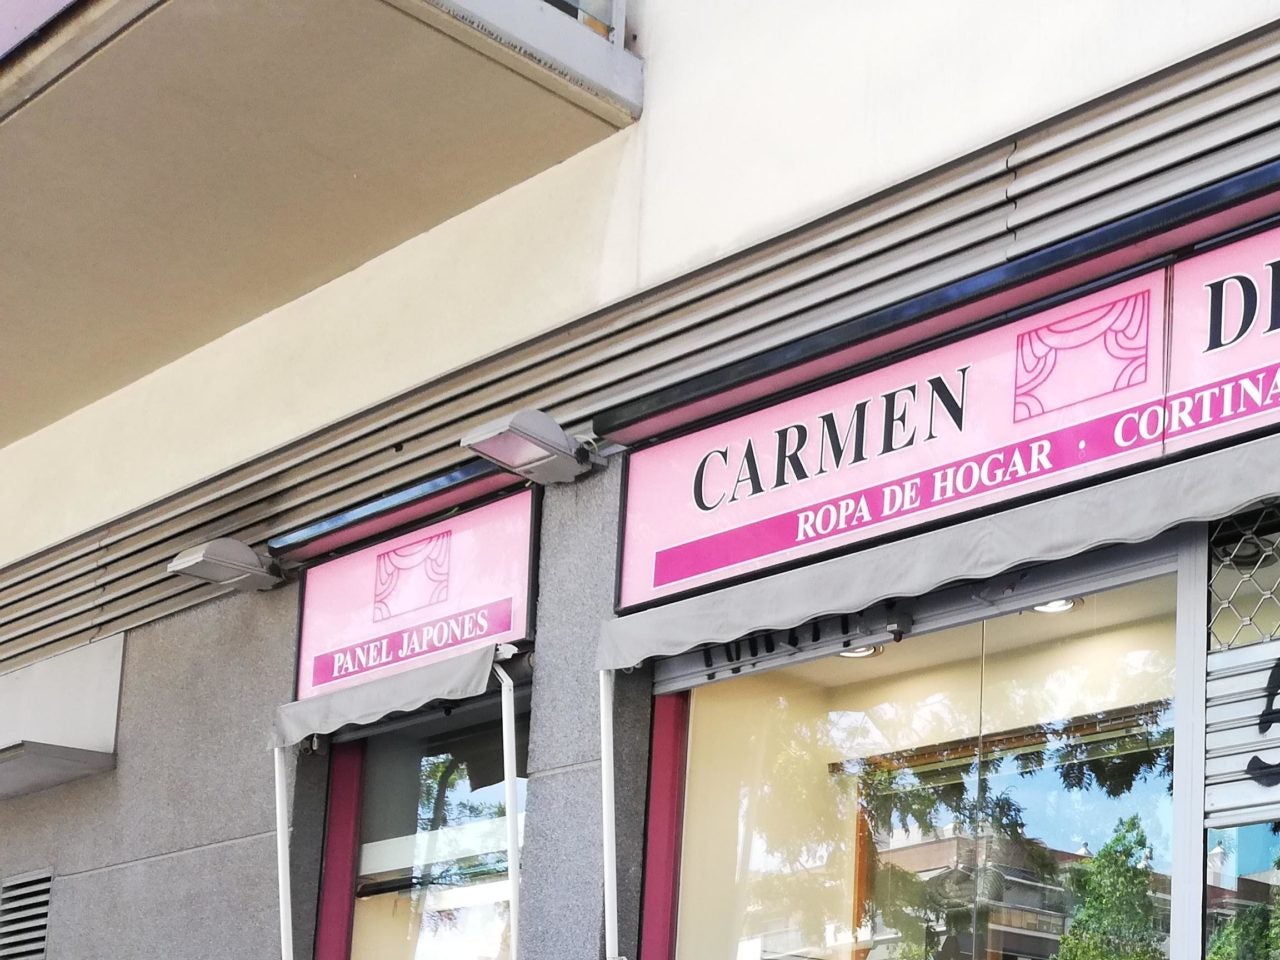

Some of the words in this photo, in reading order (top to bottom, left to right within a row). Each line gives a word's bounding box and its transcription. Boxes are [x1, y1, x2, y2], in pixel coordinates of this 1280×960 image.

[693, 365, 972, 512] CARMEN
[795, 498, 873, 542] ROPA
[881, 477, 921, 516] DE
[932, 438, 1053, 502] HOGAR
[331, 641, 394, 678] PANEL
[398, 609, 488, 659] JAPONES
